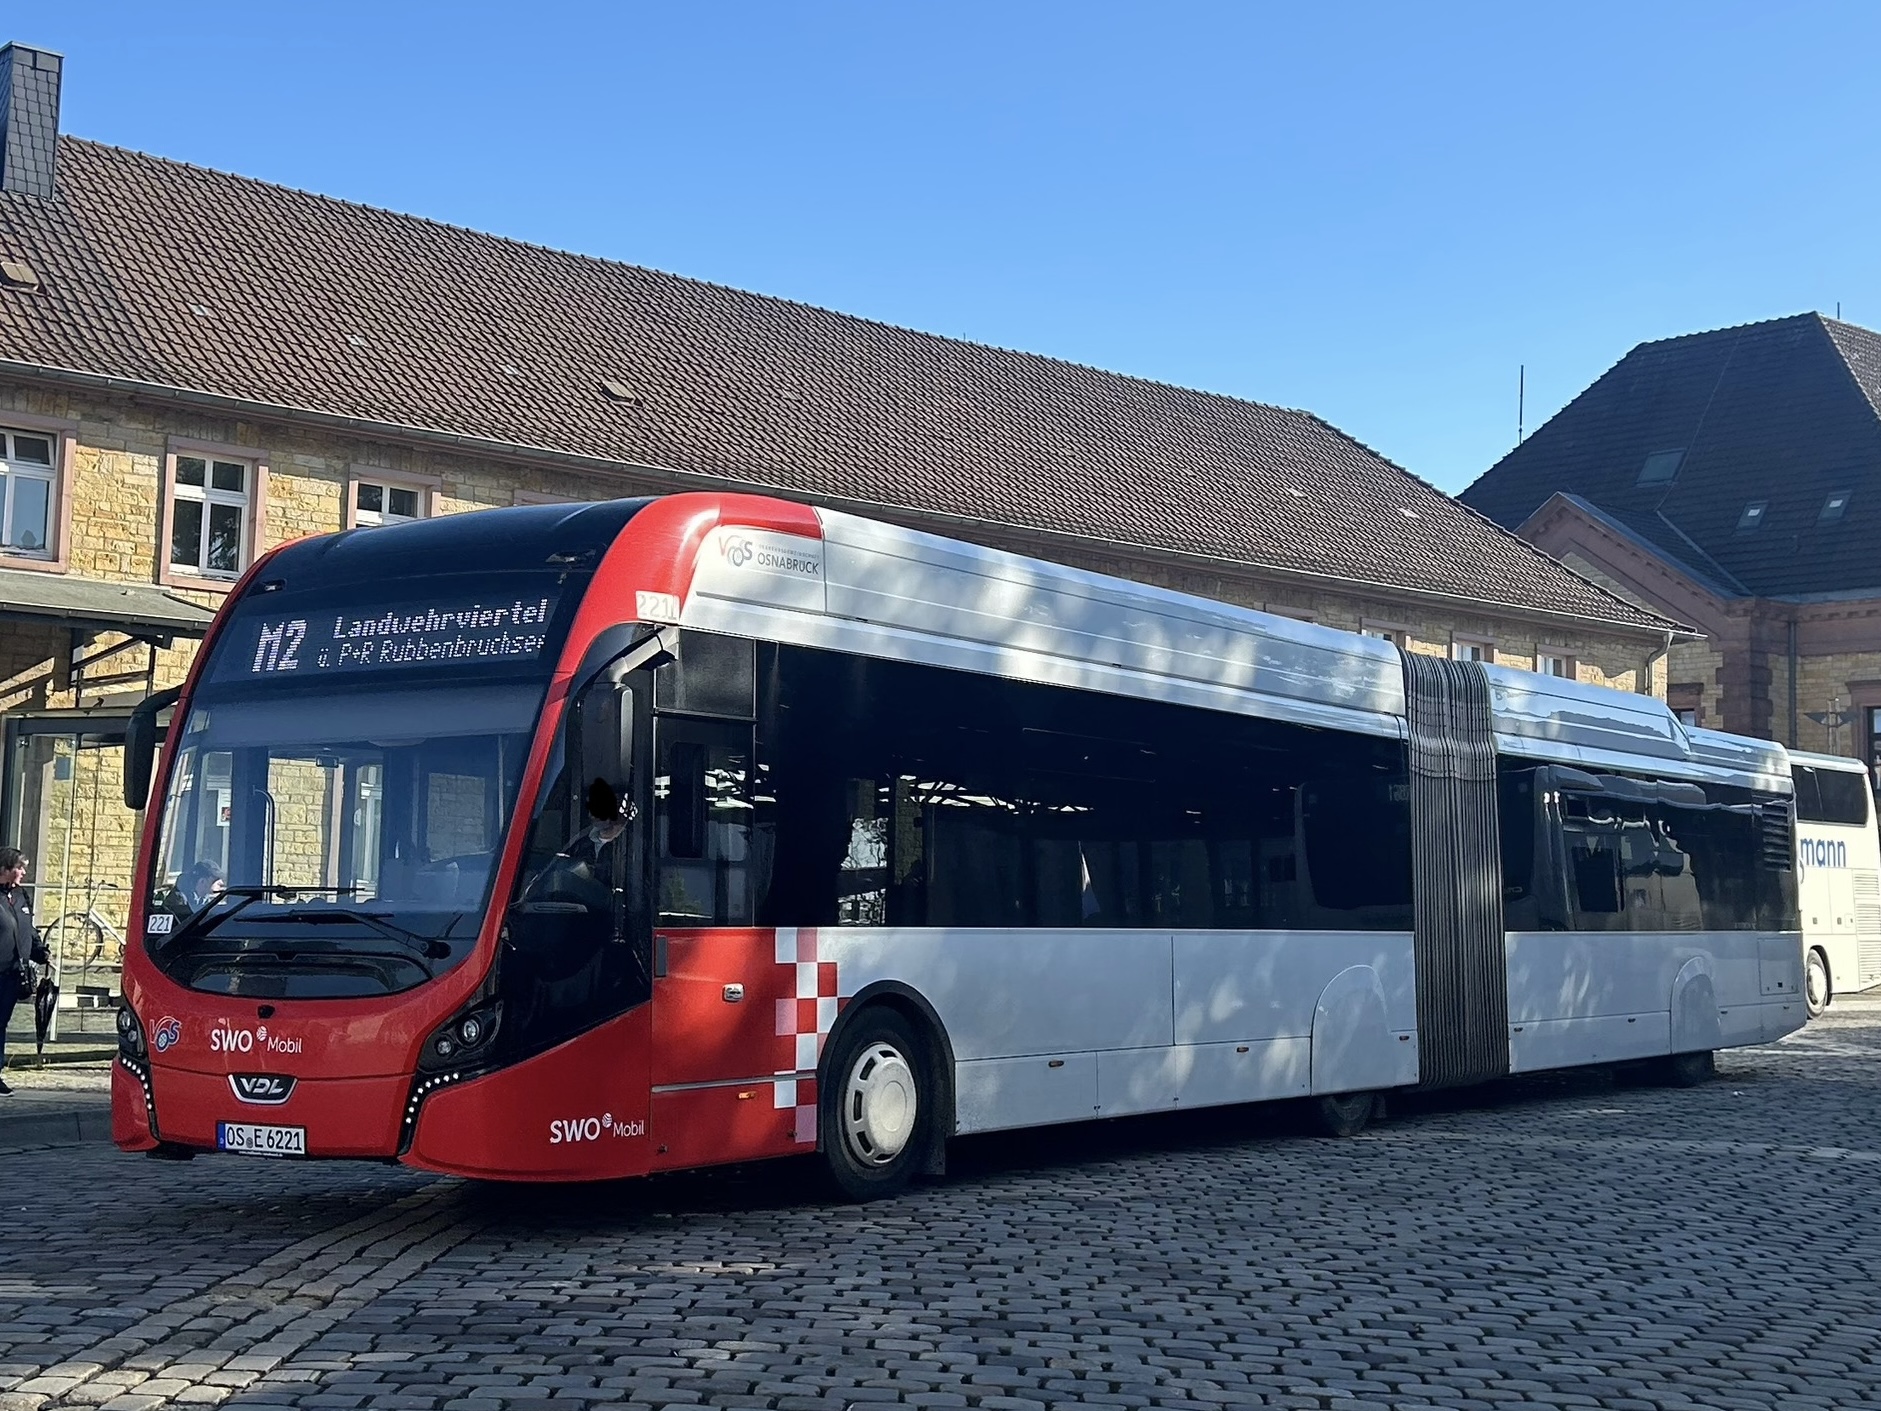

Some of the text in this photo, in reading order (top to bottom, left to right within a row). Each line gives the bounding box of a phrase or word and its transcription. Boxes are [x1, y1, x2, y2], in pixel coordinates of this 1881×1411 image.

[333, 598, 548, 639] Landwehrviertel
[252, 619, 307, 672] M2
[338, 641, 374, 665] P+R
[1799, 838, 1847, 884] mann
[149, 916, 171, 932] 221
[210, 1028, 302, 1054] SWO Mobil
[240, 1077, 284, 1095] VDL
[226, 1126, 244, 1146] OS
[254, 1128, 263, 1148] E
[266, 1129, 302, 1151] 6221
[550, 1117, 645, 1144] SWO Mobil
